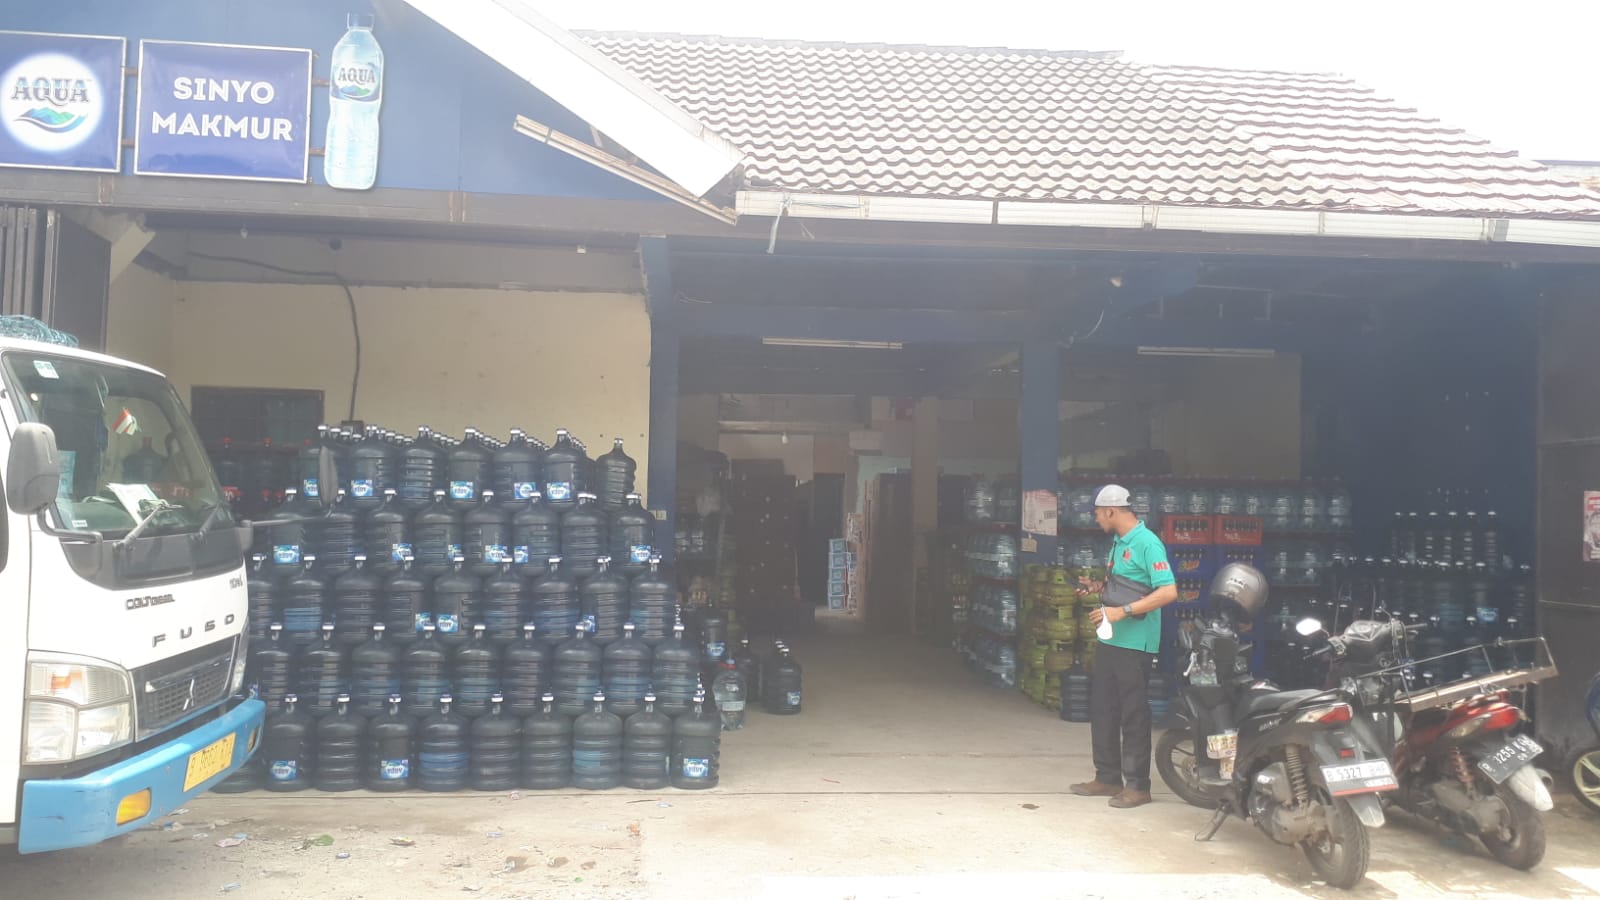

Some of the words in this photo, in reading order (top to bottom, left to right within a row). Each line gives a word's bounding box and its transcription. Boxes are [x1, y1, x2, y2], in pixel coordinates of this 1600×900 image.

[337, 66, 376, 85] AQUA
[11, 76, 90, 106] AQUA
[173, 76, 275, 105] SINYO
[151, 111, 293, 141] MAKMUR
[152, 613, 235, 648] FUSO
[1492, 745, 1516, 764] 1255
[1337, 767, 1362, 779] 5327
